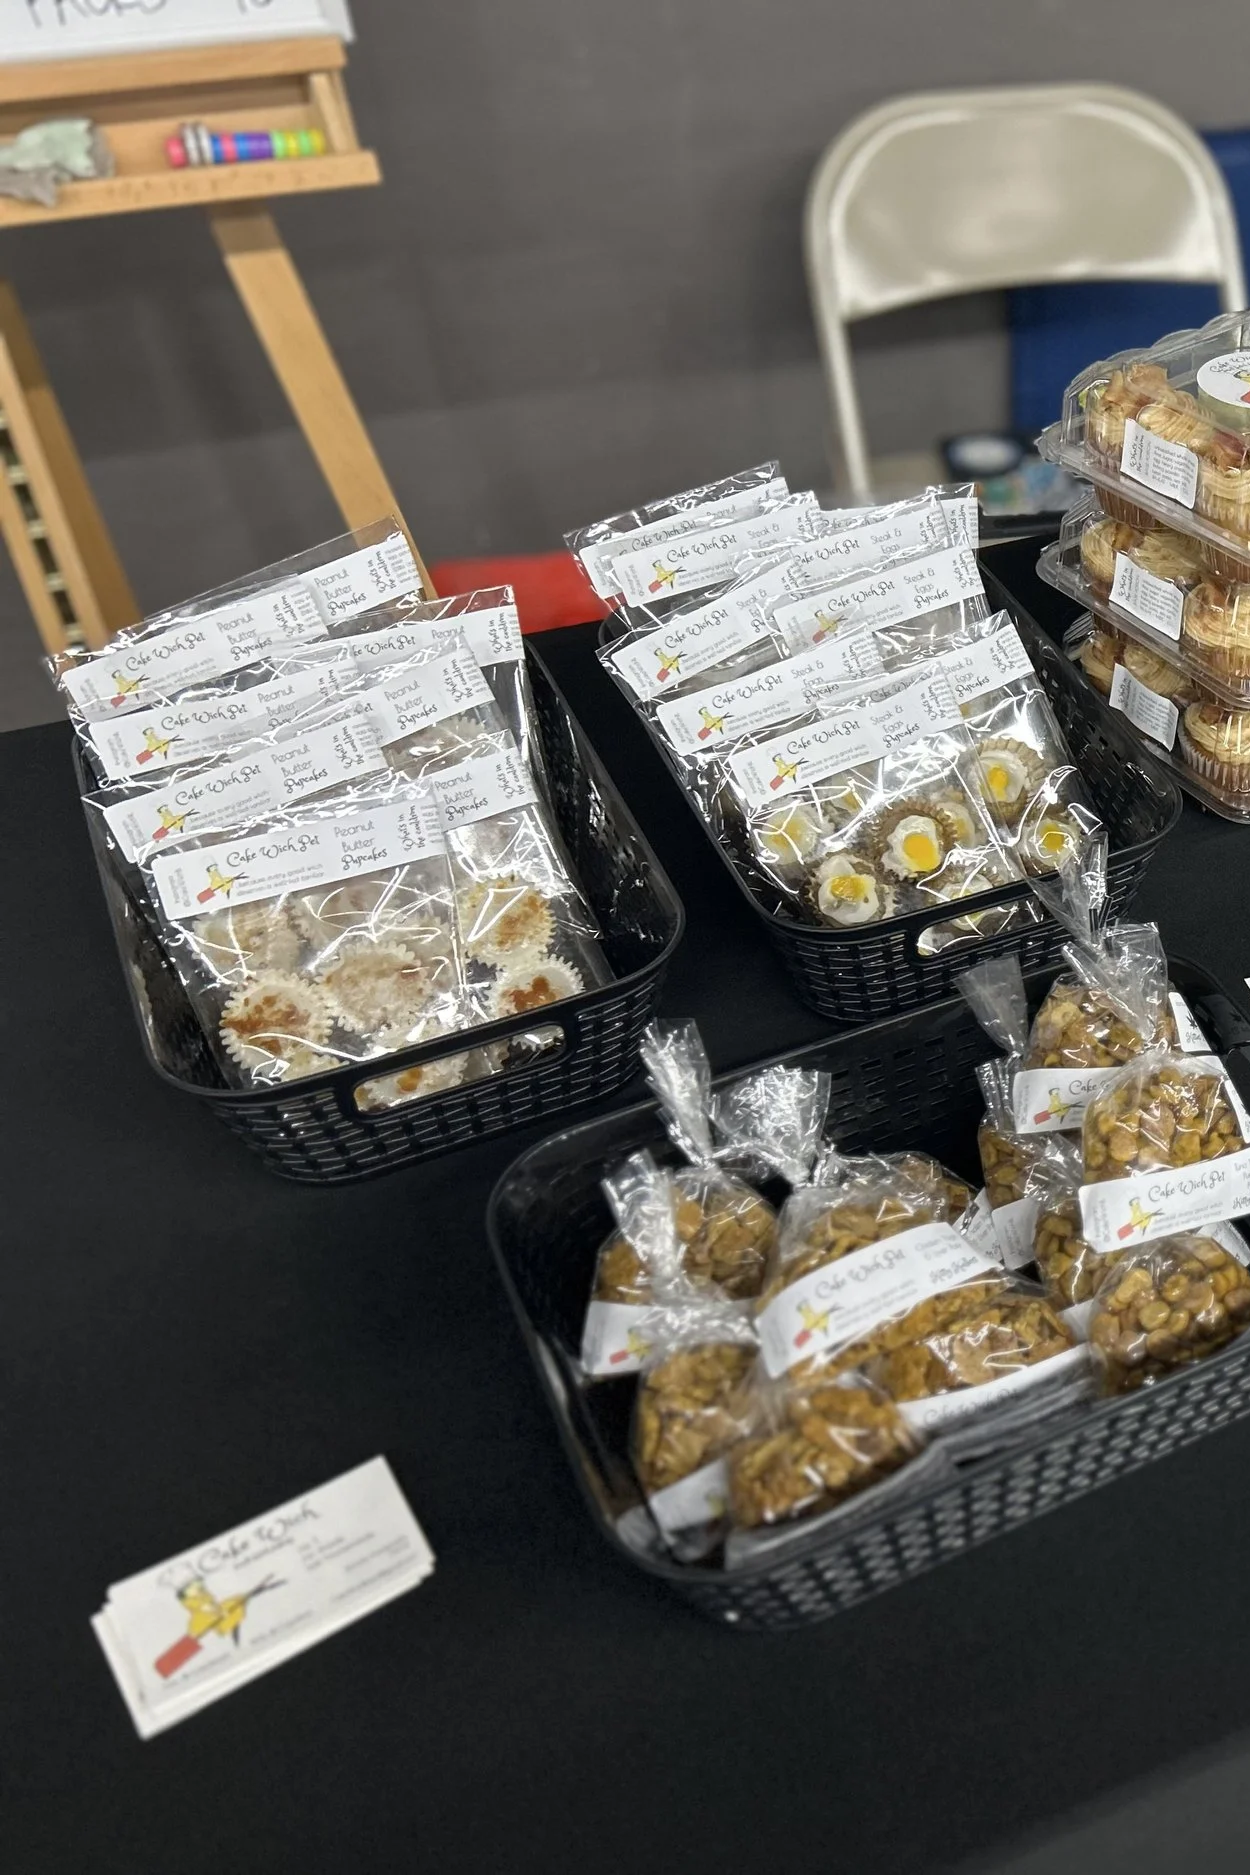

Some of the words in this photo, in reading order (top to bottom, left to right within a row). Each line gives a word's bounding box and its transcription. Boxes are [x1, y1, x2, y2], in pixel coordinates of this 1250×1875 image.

[1210, 361, 1229, 373] Cake
[632, 533, 653, 551] Cake
[653, 527, 681, 542] Wich
[747, 527, 770, 540] Steak
[870, 533, 892, 544] Steak
[667, 548, 690, 562] Cake
[692, 541, 720, 556] Wich
[718, 534, 737, 548] Pet
[794, 551, 815, 566] Cake
[815, 546, 843, 560] Wich
[842, 538, 860, 555] Pet
[881, 542, 901, 554] Eggs
[314, 569, 350, 587] Peanut
[904, 573, 926, 585] Steak
[914, 582, 934, 595] Eggs
[326, 585, 352, 599] Butter
[828, 596, 851, 612] Cake
[851, 584, 879, 603] Wich
[877, 580, 895, 597] Pet
[913, 589, 949, 610] Pupcakes
[327, 593, 367, 616] Pupcakes
[216, 612, 254, 633] Peanut
[665, 630, 688, 649] Cake
[688, 618, 715, 636] Wich
[711, 609, 729, 629] Pet
[228, 630, 257, 645] Butter
[365, 637, 396, 656] Wich
[396, 635, 416, 651] Pet
[126, 649, 151, 671] Cake
[151, 640, 186, 662] Wich
[184, 631, 206, 652] Pet
[230, 637, 272, 661] Pupcakes
[791, 664, 815, 679] Steak
[943, 664, 963, 676] Steak
[955, 672, 974, 684] Eggs
[258, 685, 295, 703] Peanut
[384, 680, 421, 701] Peanut
[712, 692, 735, 708] Cake
[736, 682, 766, 699] Wich
[764, 674, 783, 690] Pet
[802, 683, 839, 704] Pupcakes
[955, 676, 990, 697] Pupcakes
[396, 695, 423, 714] Butter
[871, 711, 894, 726] Steak
[896, 704, 904, 714] &
[161, 711, 190, 730] Cake
[192, 708, 225, 724] Wich
[225, 703, 247, 720] Pet
[397, 704, 438, 730] Pupcakes
[883, 720, 904, 734] Eggs
[787, 738, 813, 755] Cake
[814, 725, 846, 744] Wich
[843, 720, 860, 736] Pet
[883, 722, 920, 748] Pupcakes
[271, 744, 310, 764] Peanut
[281, 759, 315, 778] Butter
[175, 786, 204, 806] Cake
[205, 773, 240, 793] Wich
[240, 764, 261, 781] Pet
[283, 767, 328, 794] Pupcakes
[434, 773, 472, 791] Peanut
[444, 787, 475, 804] Butter
[445, 797, 488, 821] Pupcakes
[334, 820, 375, 838] Peanut
[227, 850, 258, 867] Cake
[259, 840, 297, 859] Wich
[296, 834, 320, 852] Pet
[341, 836, 375, 852] Butter
[342, 848, 388, 871] Pupcakes
[1069, 1079, 1097, 1095] Cake
[1148, 1183, 1175, 1202] Cake
[1176, 1174, 1208, 1195] Wich
[1207, 1169, 1225, 1189] Pet
[815, 1275, 847, 1299] Cake
[847, 1256, 885, 1282] Wich
[882, 1249, 906, 1269] Pet
[199, 1536, 250, 1574] Cake
[253, 1501, 319, 1540] Wich
